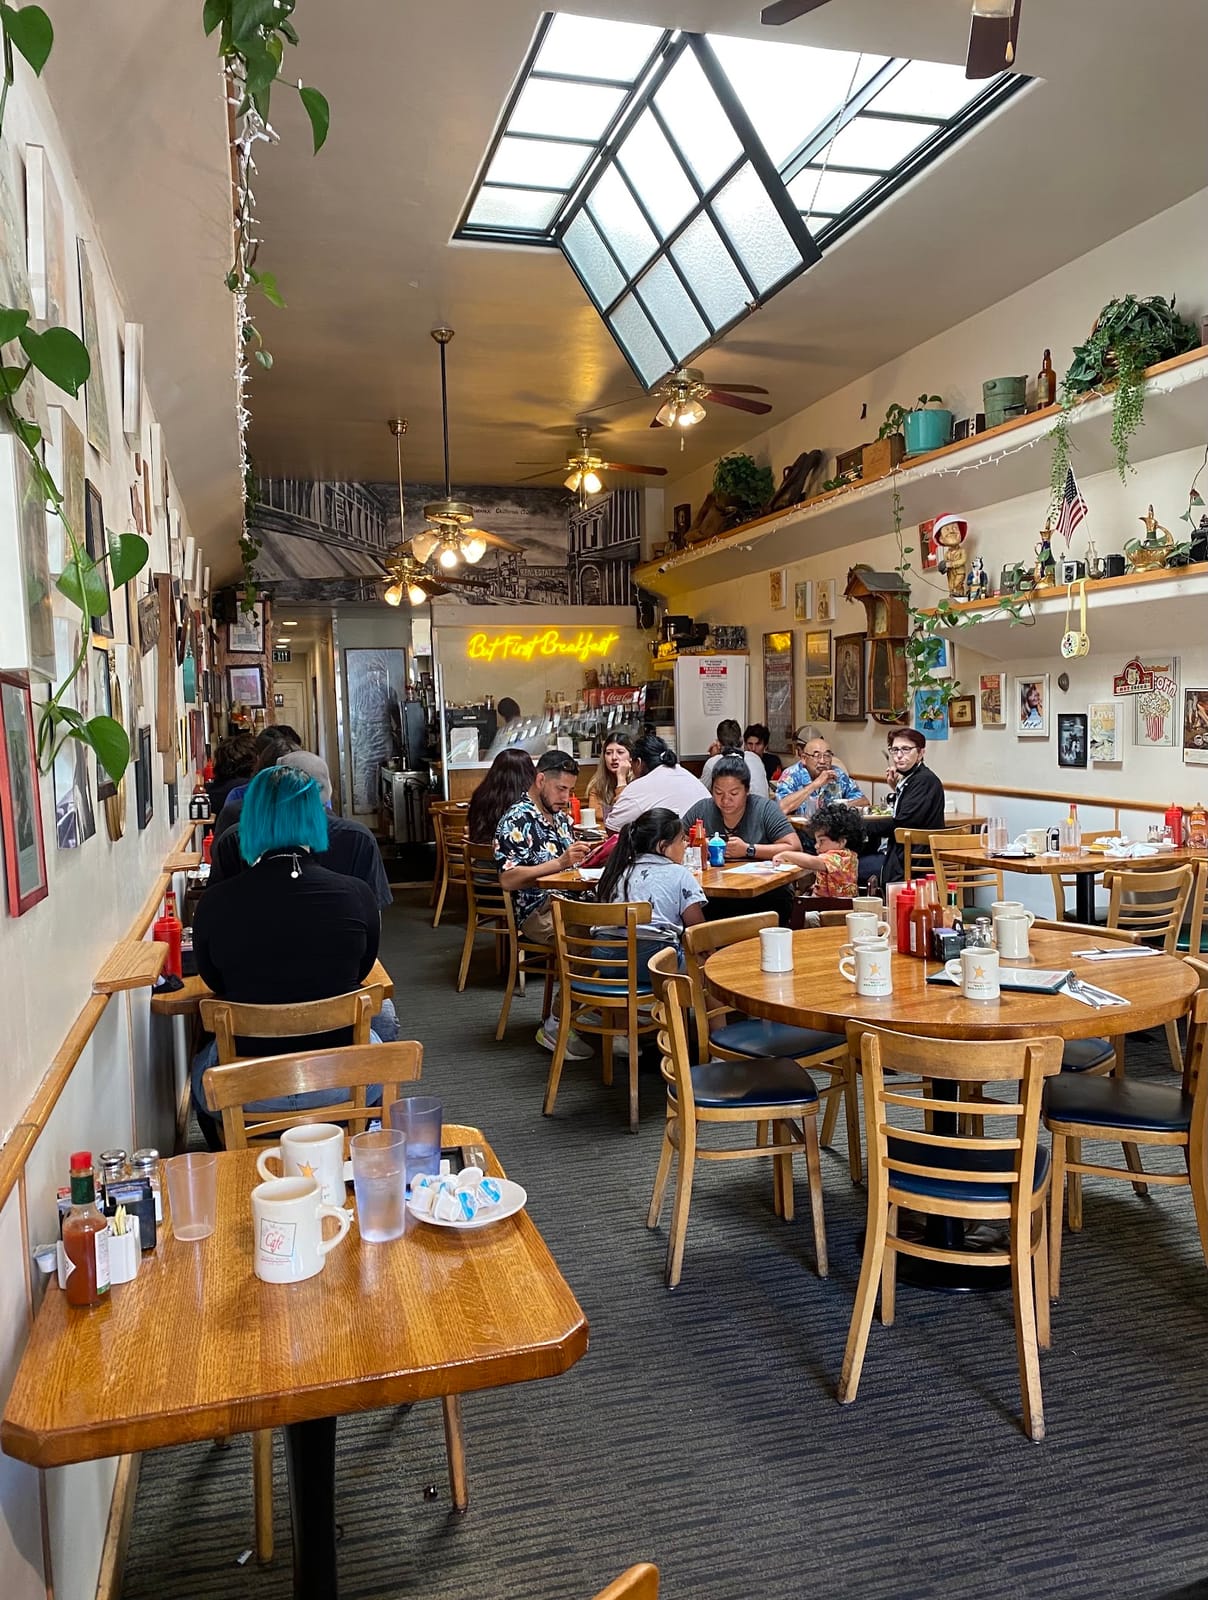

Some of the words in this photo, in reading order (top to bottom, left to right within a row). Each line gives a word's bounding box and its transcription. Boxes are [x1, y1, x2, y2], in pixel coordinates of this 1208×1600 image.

[273, 651, 288, 662] EXIT
[469, 633, 500, 662] But
[503, 635, 542, 661] First
[541, 630, 620, 663] Breakfast
